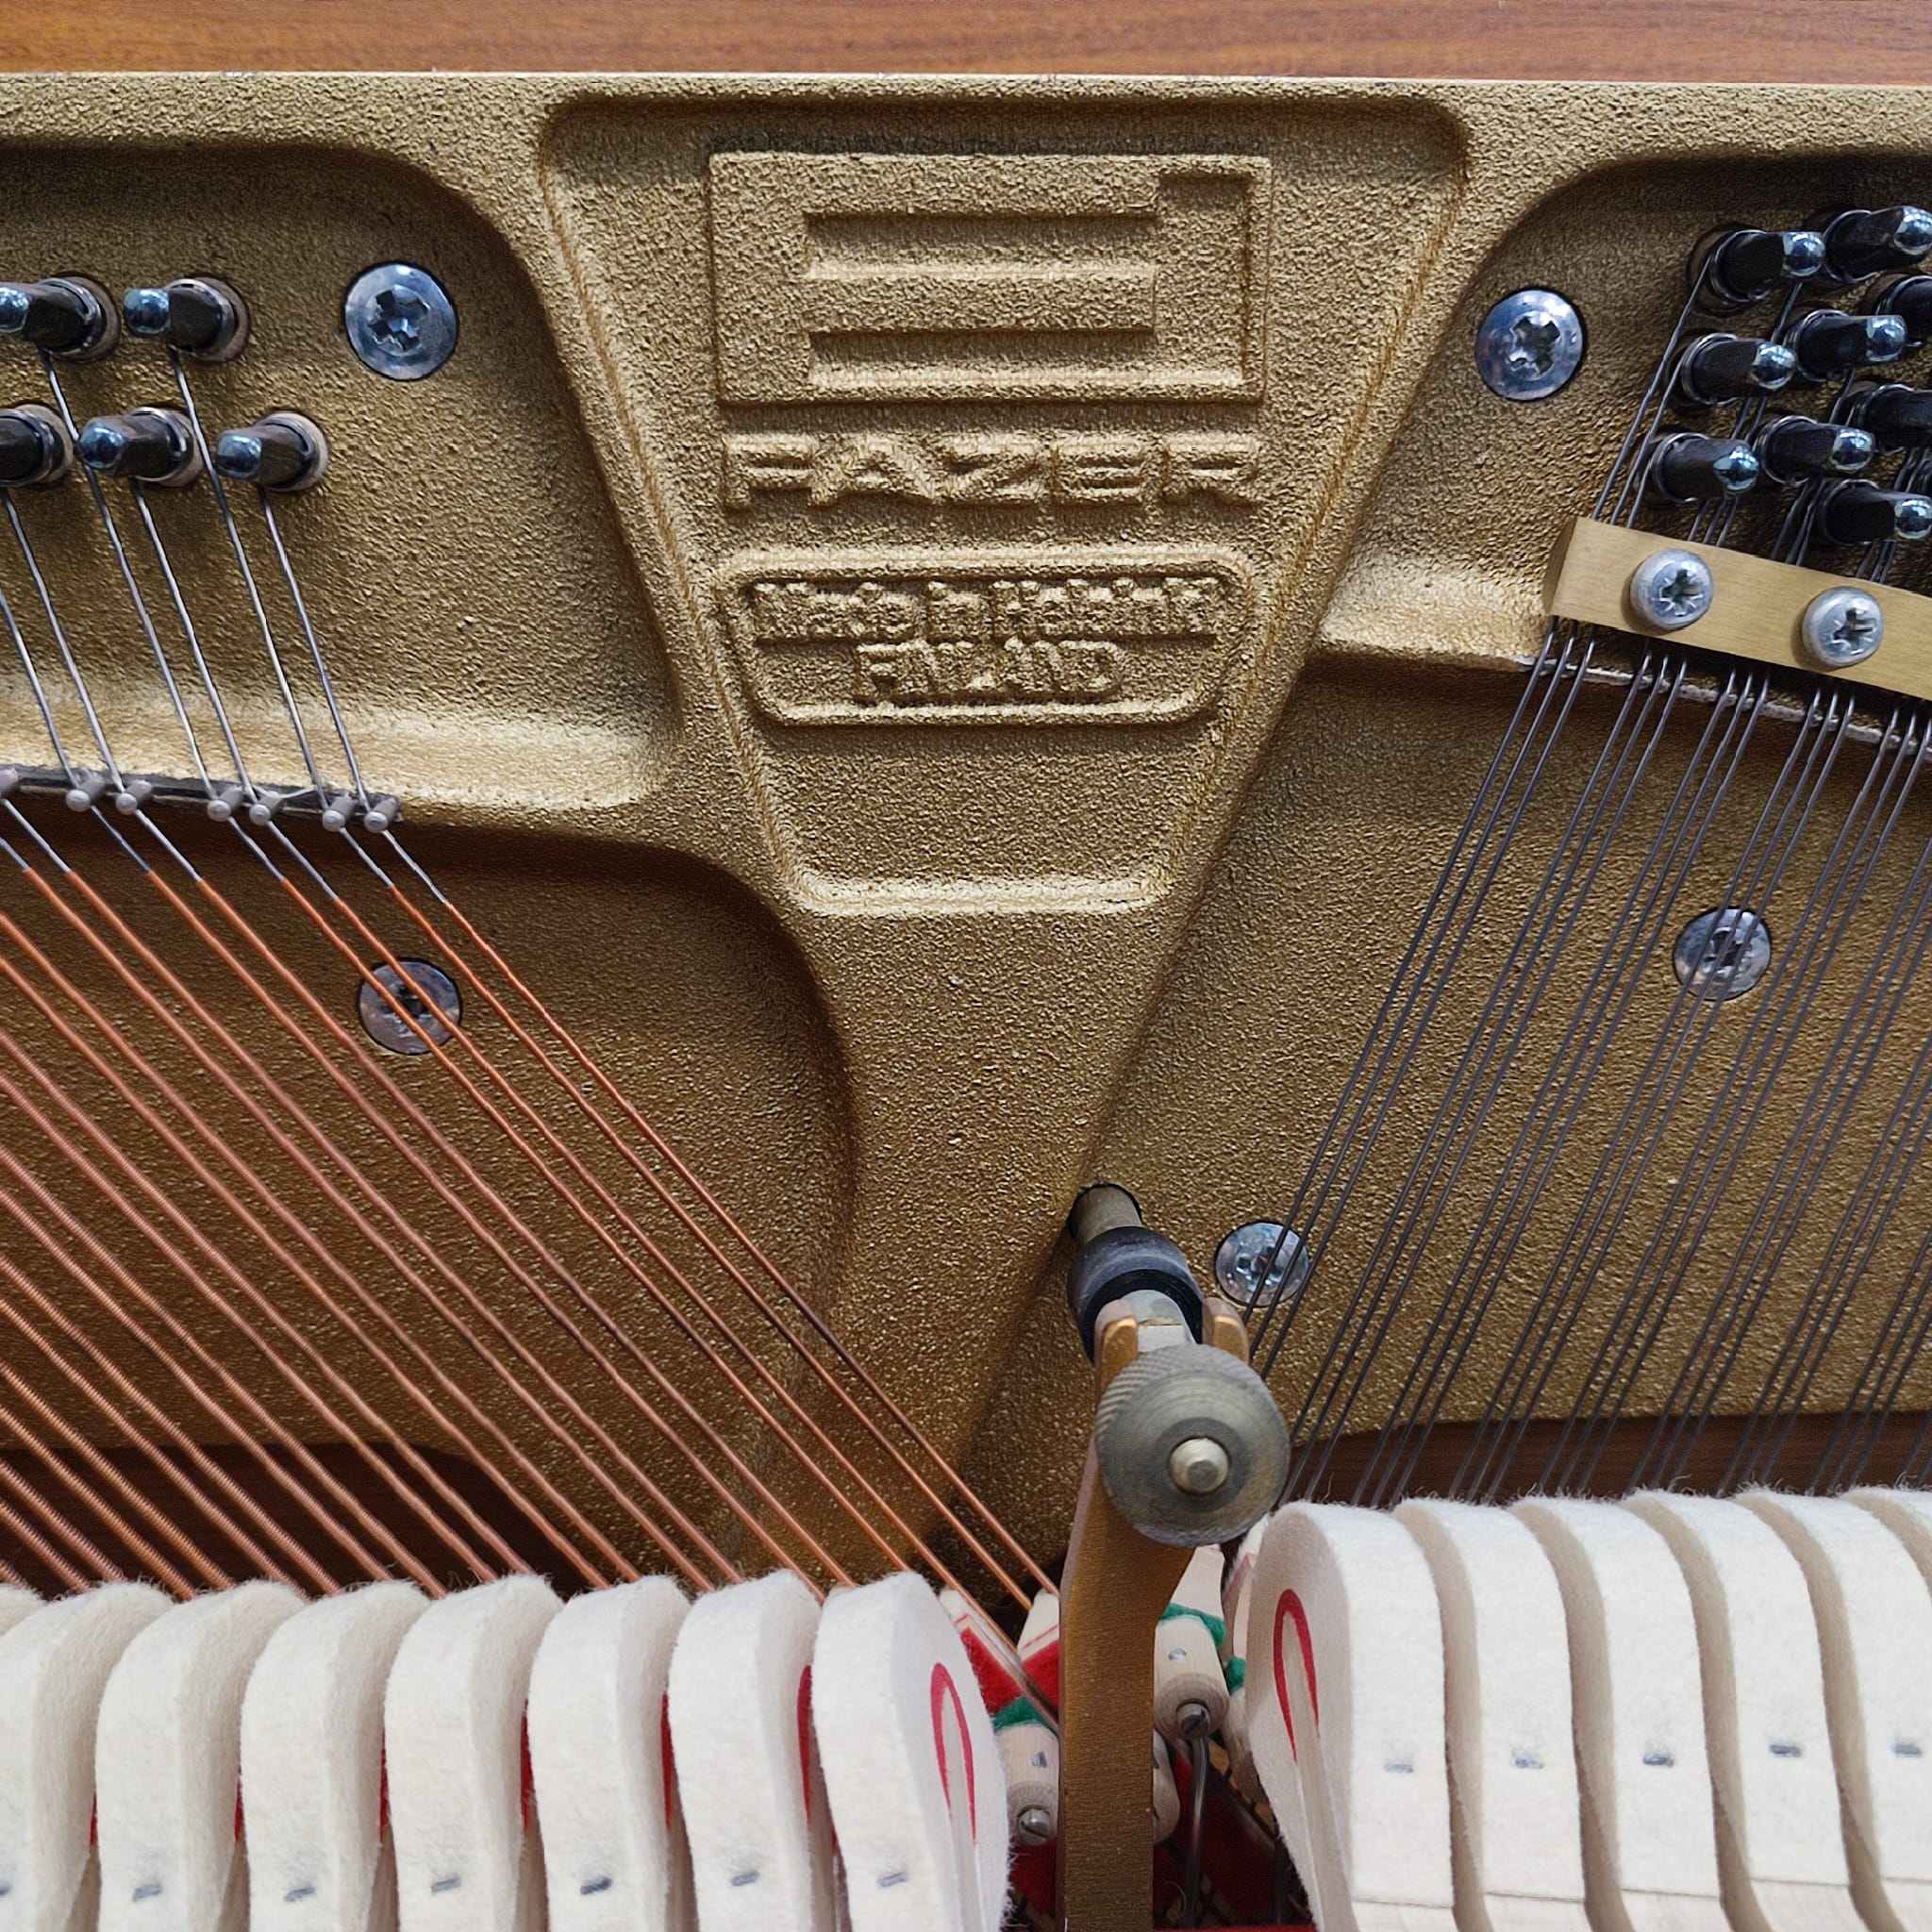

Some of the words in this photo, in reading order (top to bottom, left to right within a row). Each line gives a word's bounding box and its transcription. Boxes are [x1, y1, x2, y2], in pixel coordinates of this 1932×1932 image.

[723, 430, 1260, 509] FAZER
[754, 580, 920, 641] Made
[926, 579, 988, 640] in
[853, 636, 1124, 702] FINLAND
